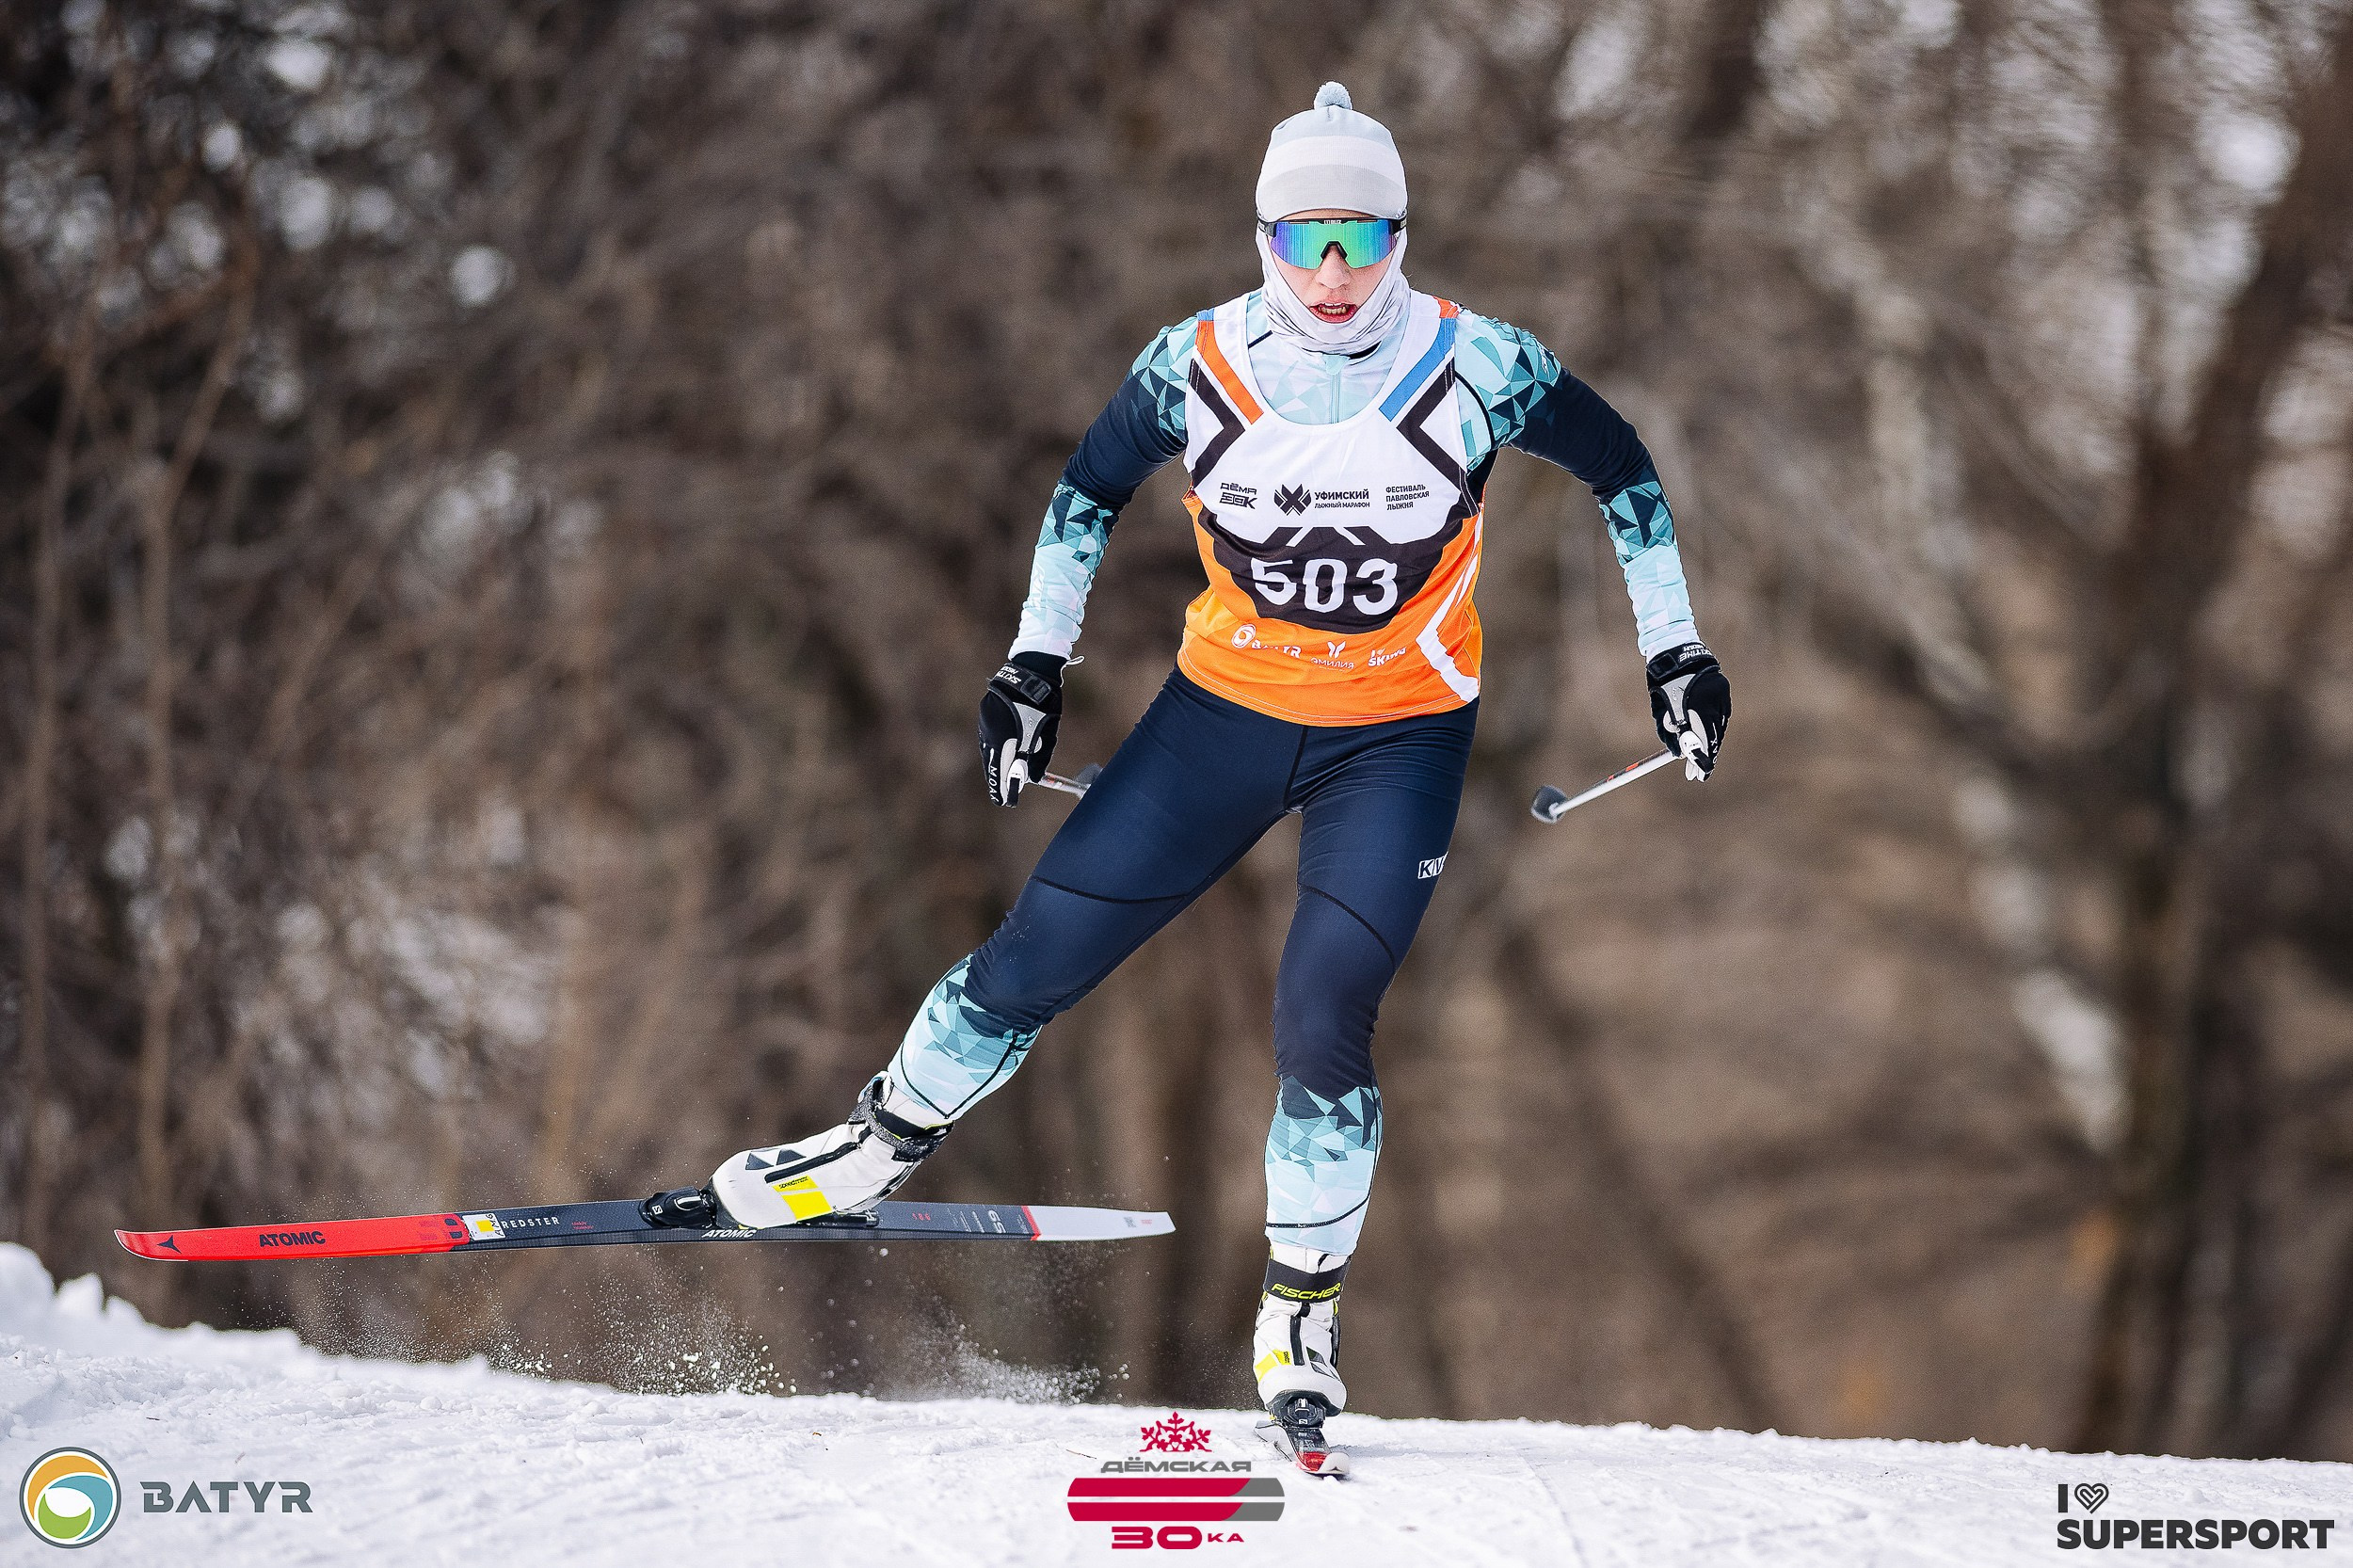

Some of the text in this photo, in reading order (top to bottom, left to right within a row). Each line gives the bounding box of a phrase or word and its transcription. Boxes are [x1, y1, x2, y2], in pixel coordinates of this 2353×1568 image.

[1314, 488, 1369, 500] УФИМСКИЙ
[1385, 484, 1426, 493] ФЕСТИВАЛЬ
[1385, 490, 1430, 502] ПАВЛОВСКАЯ
[1386, 501, 1414, 511] ЛЫЖНЯ
[1251, 557, 1398, 616] 503
[501, 1216, 560, 1228] REDSTER
[259, 1231, 326, 1247] ATOMIC
[701, 1229, 757, 1239] ATOMIC
[1271, 1282, 1341, 1299] FISCHER
